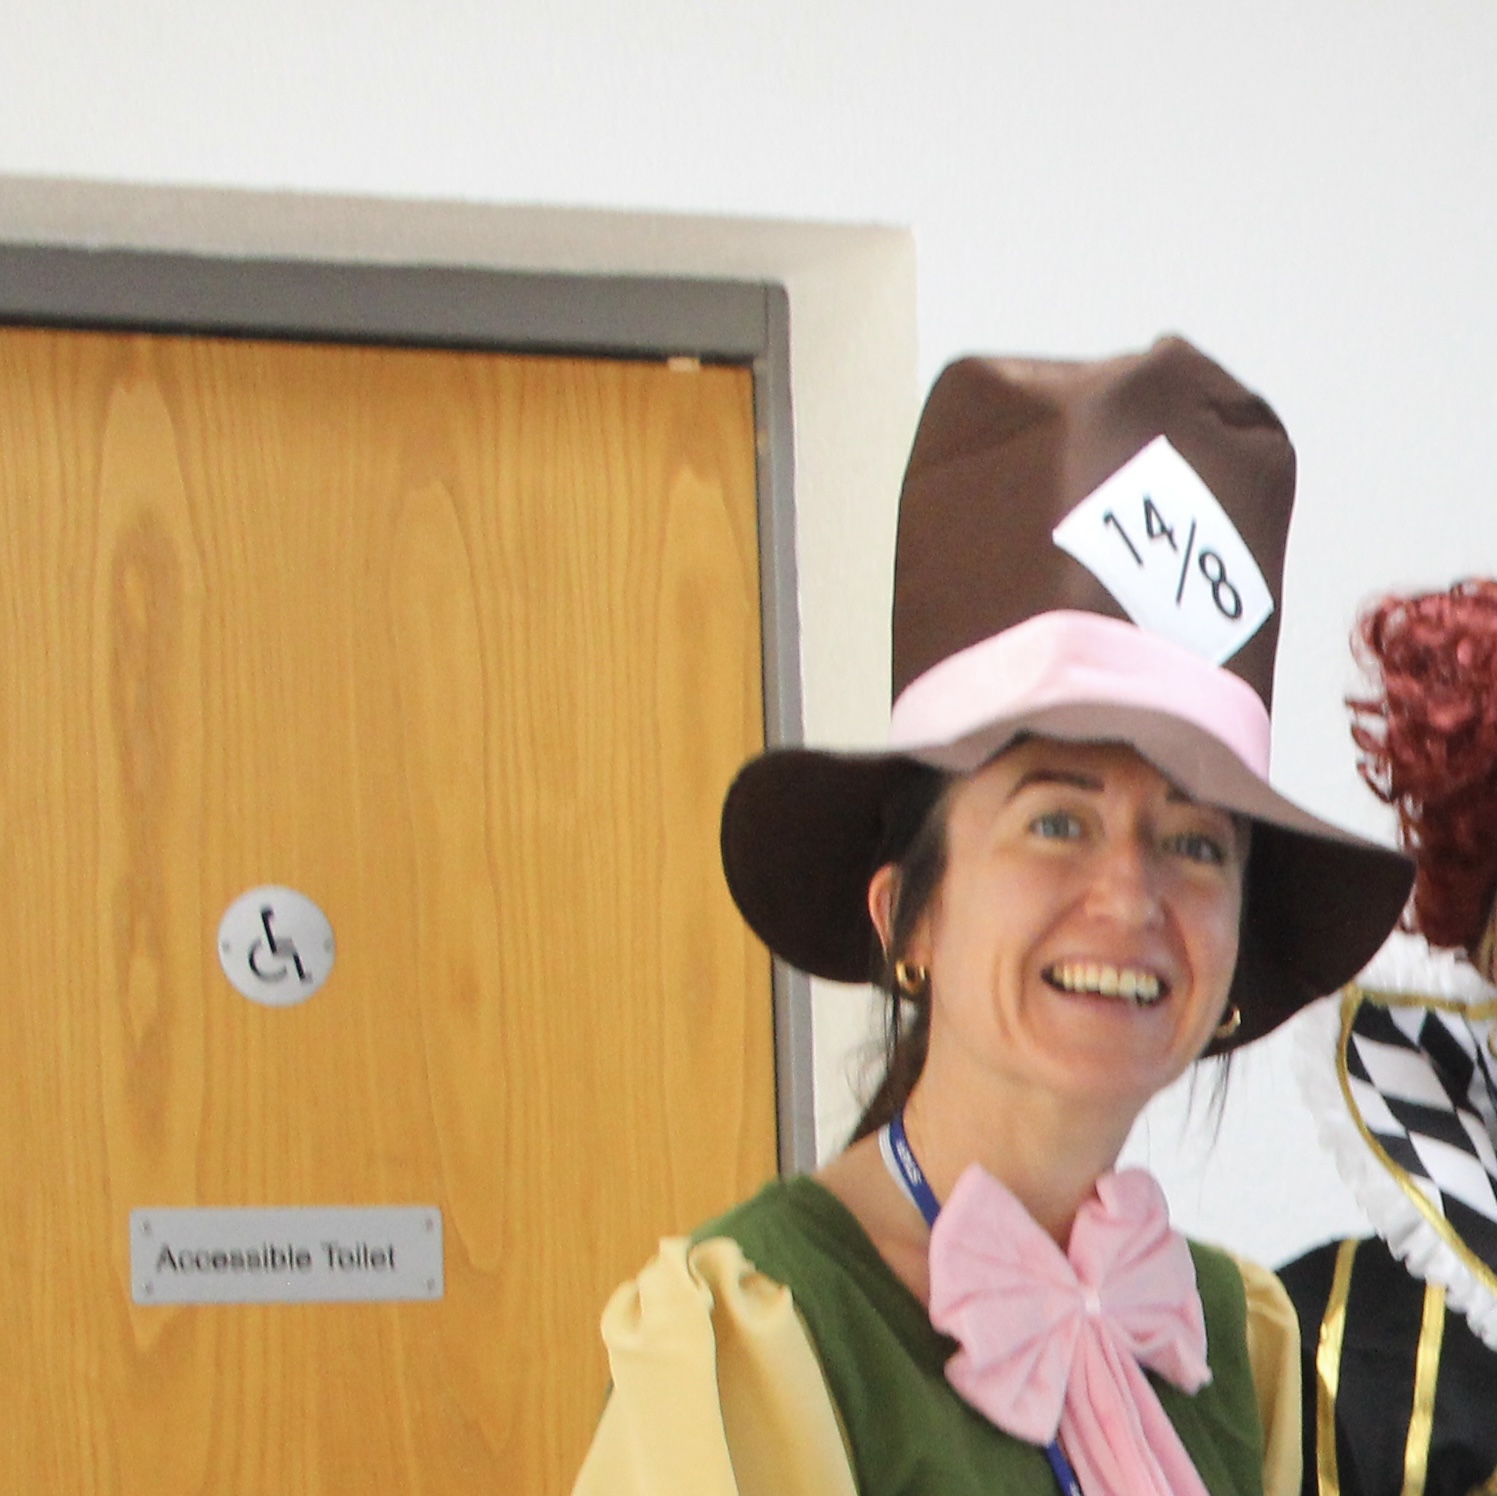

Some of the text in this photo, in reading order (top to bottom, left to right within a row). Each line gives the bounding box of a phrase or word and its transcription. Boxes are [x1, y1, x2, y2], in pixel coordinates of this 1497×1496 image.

[1102, 495, 1243, 619] 14/8
[156, 1241, 397, 1272] Accessible Toilet
